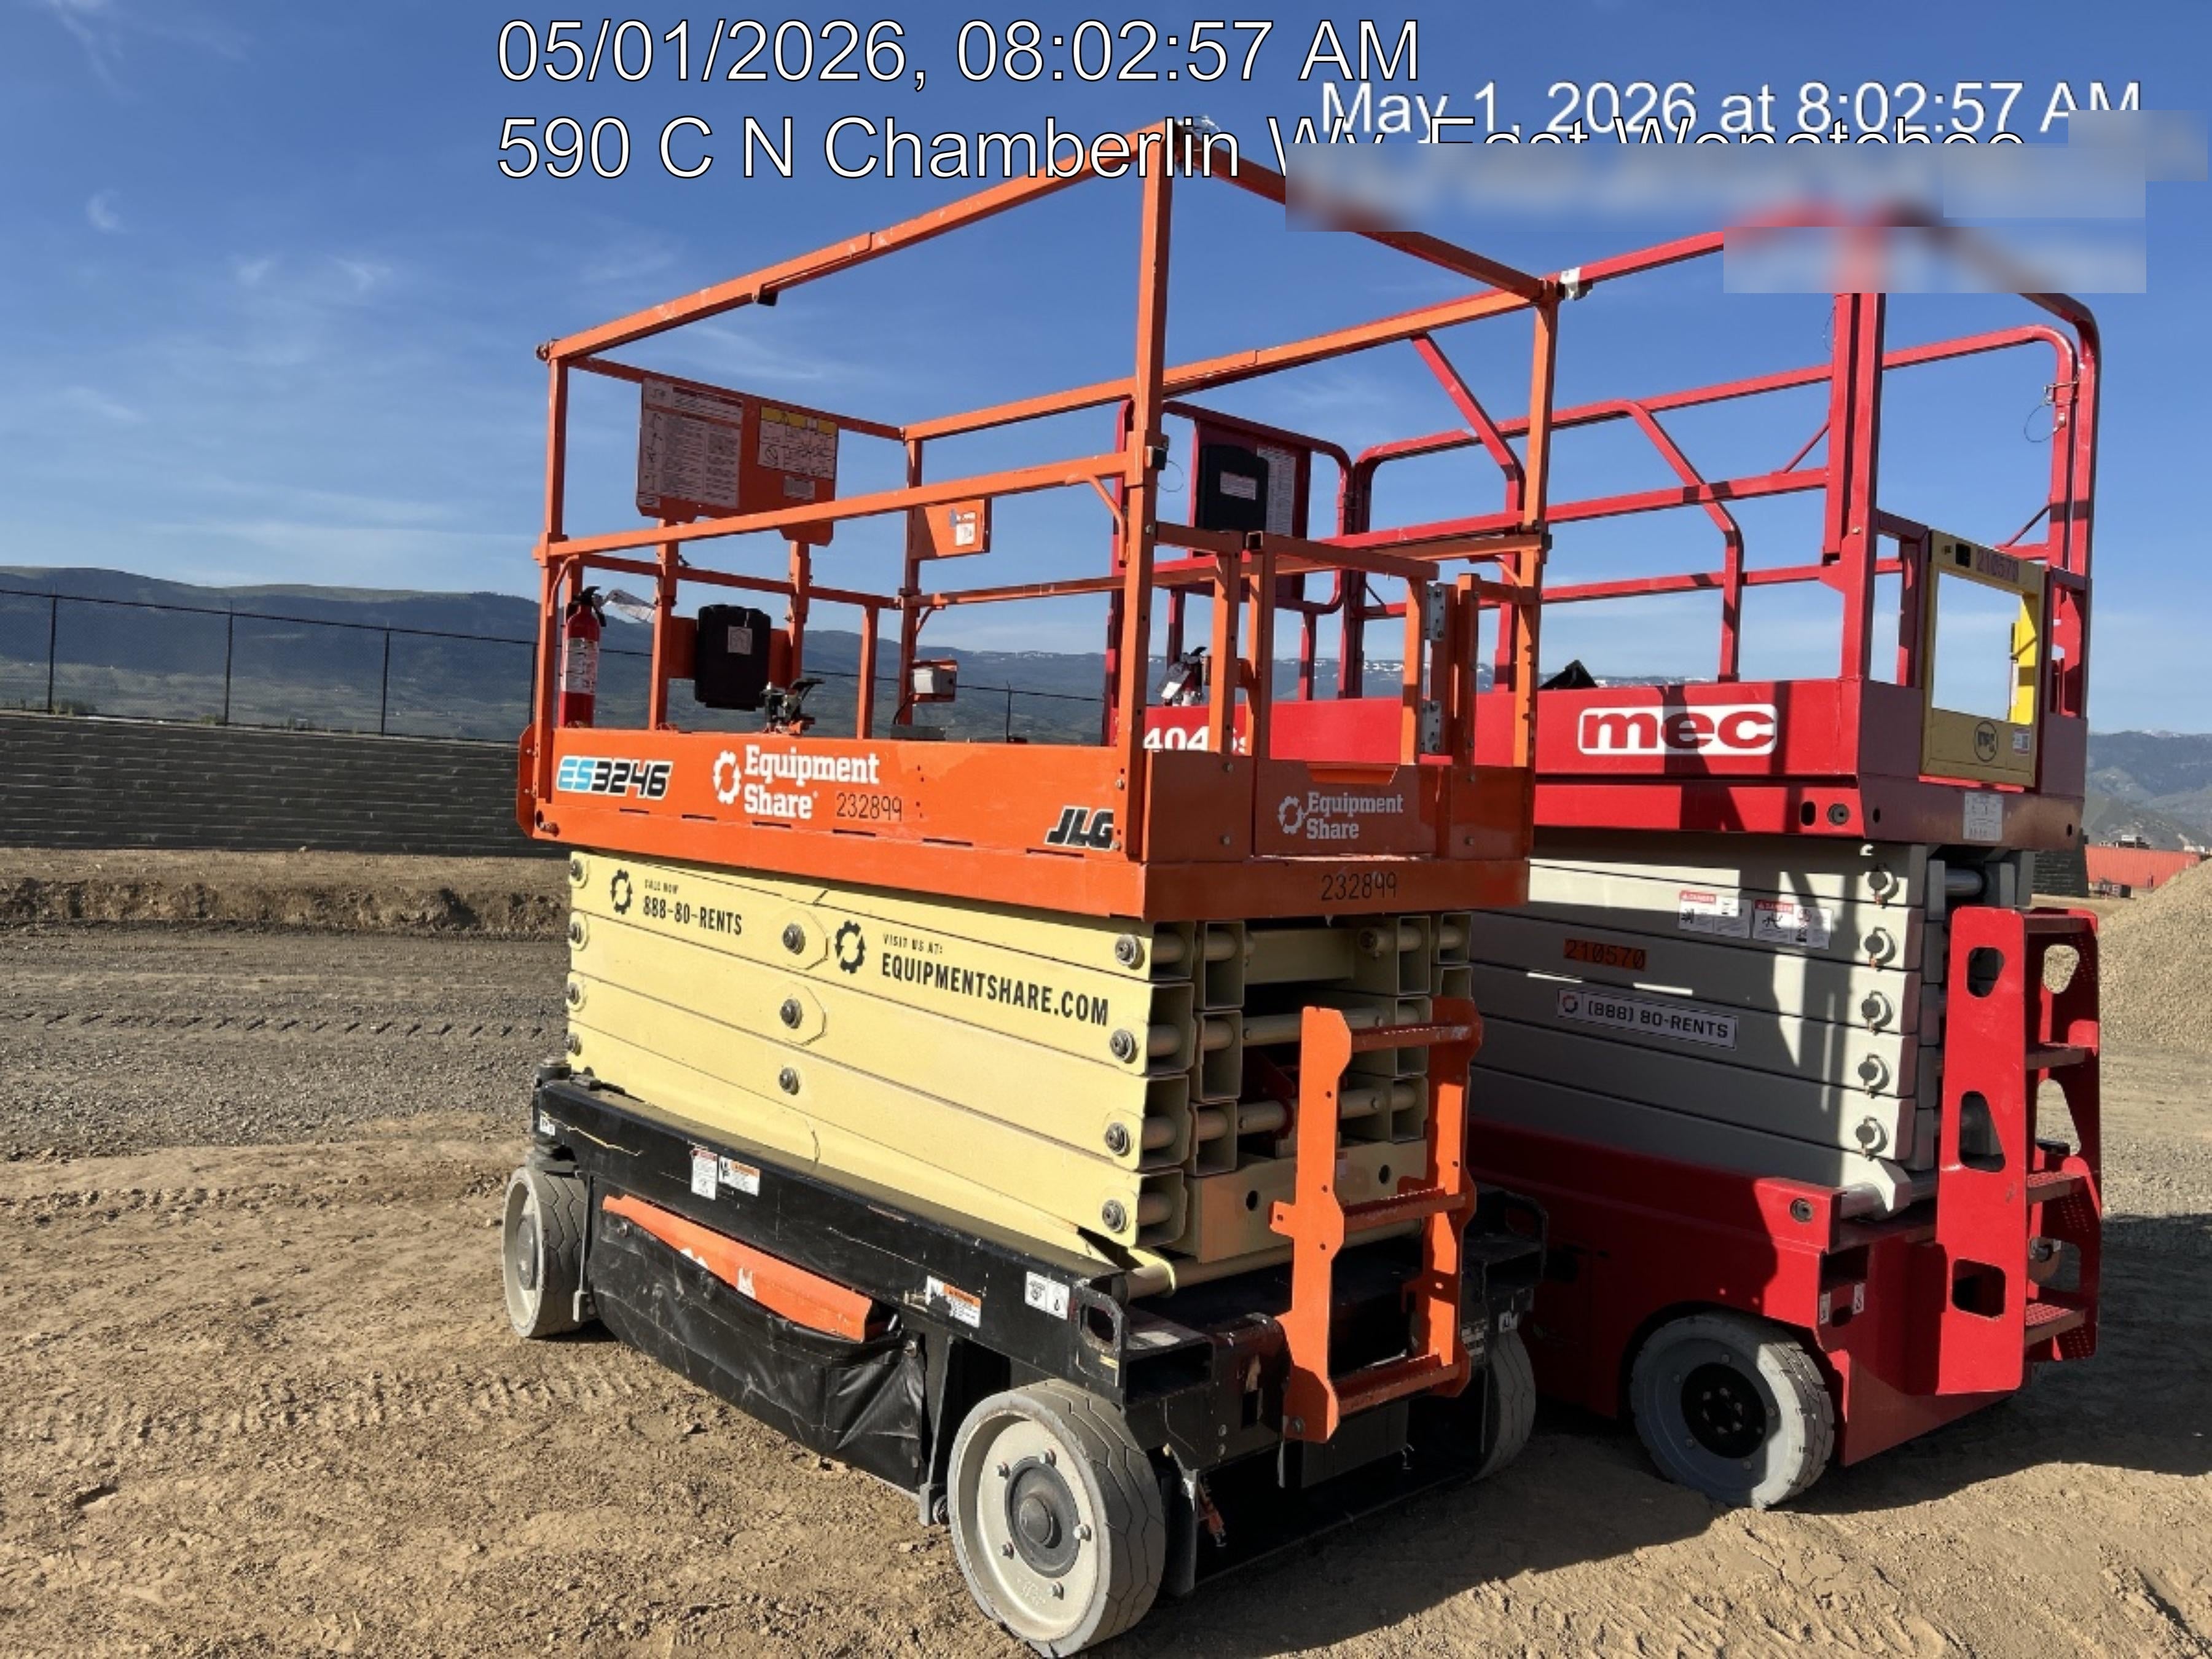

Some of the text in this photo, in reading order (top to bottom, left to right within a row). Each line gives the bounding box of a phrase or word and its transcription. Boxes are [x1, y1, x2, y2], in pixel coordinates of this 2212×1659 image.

[1582, 711, 1775, 749] mec
[556, 755, 673, 801] ES3246
[744, 745, 880, 784] Equipment
[744, 783, 814, 819] Share
[836, 793, 903, 822] 232899
[1306, 791, 1404, 816] Equipment
[1044, 806, 1114, 852] JLG
[1306, 818, 1359, 840] Share
[1321, 871, 1397, 901] 232899
[643, 895, 743, 936] 888-80-RENTS
[883, 933, 908, 949] VISIT
[912, 938, 925, 952] US
[1567, 938, 1645, 970] 210570
[882, 952, 1108, 1027] EQUIPMENTSHARE.COM
[1588, 1000, 1728, 1038] (888) 80-RENTS
